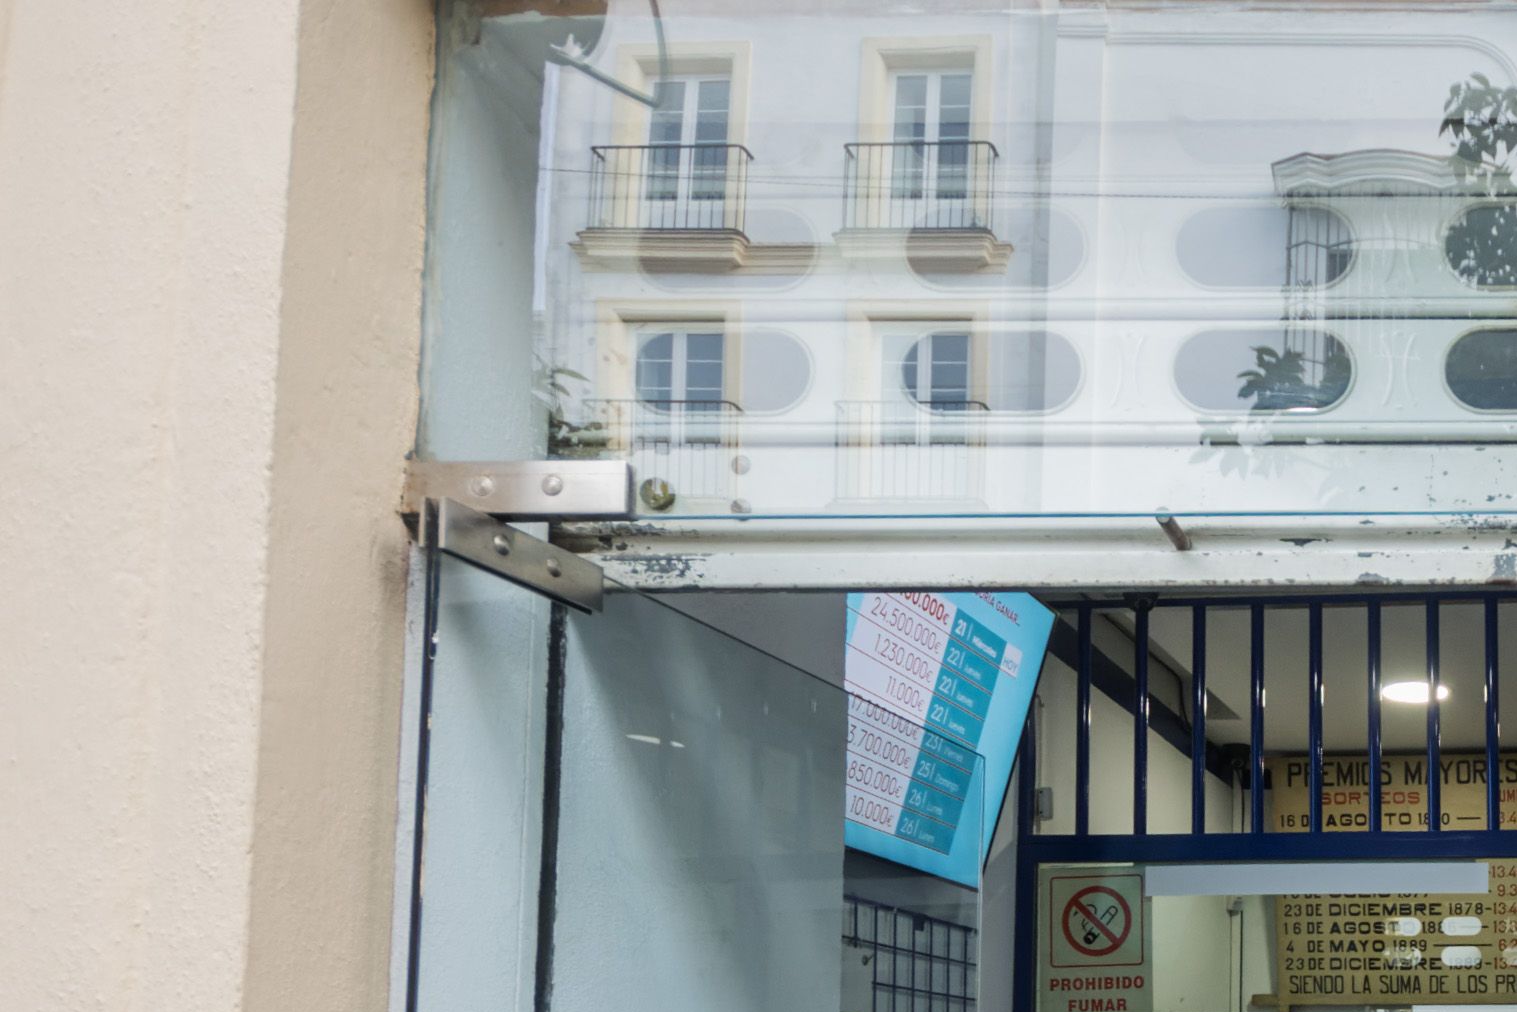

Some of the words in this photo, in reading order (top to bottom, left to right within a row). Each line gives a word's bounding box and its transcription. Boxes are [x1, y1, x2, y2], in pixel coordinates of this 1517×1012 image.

[955, 619, 967, 637] 21
[947, 647, 959, 665] 22
[937, 675, 950, 694] 22
[930, 704, 942, 721] 22
[916, 761, 930, 778] 25
[1280, 814, 1296, 828] 16
[1326, 812, 1412, 827] AGOTO
[1283, 903, 1302, 917] 23
[1306, 903, 1323, 917] DE
[1329, 903, 1442, 917] DICIEMBRE
[1284, 922, 1302, 935] 16
[1307, 922, 1324, 935] DE
[1286, 940, 1295, 953] 4
[1308, 940, 1325, 954] DE
[1330, 940, 1386, 954] MAYO
[1286, 958, 1305, 971] 23
[1309, 958, 1326, 971] DE
[1330, 957, 1443, 971] DICIEMBRE
[1049, 975, 1145, 992] PROHIBIDO
[1289, 975, 1345, 994] SIENDO
[1351, 975, 1372, 994] LA
[1380, 975, 1422, 994] SUMA
[1429, 975, 1451, 994] DE
[1456, 975, 1488, 994] LOS
[1067, 998, 1128, 1012] FUMAR
